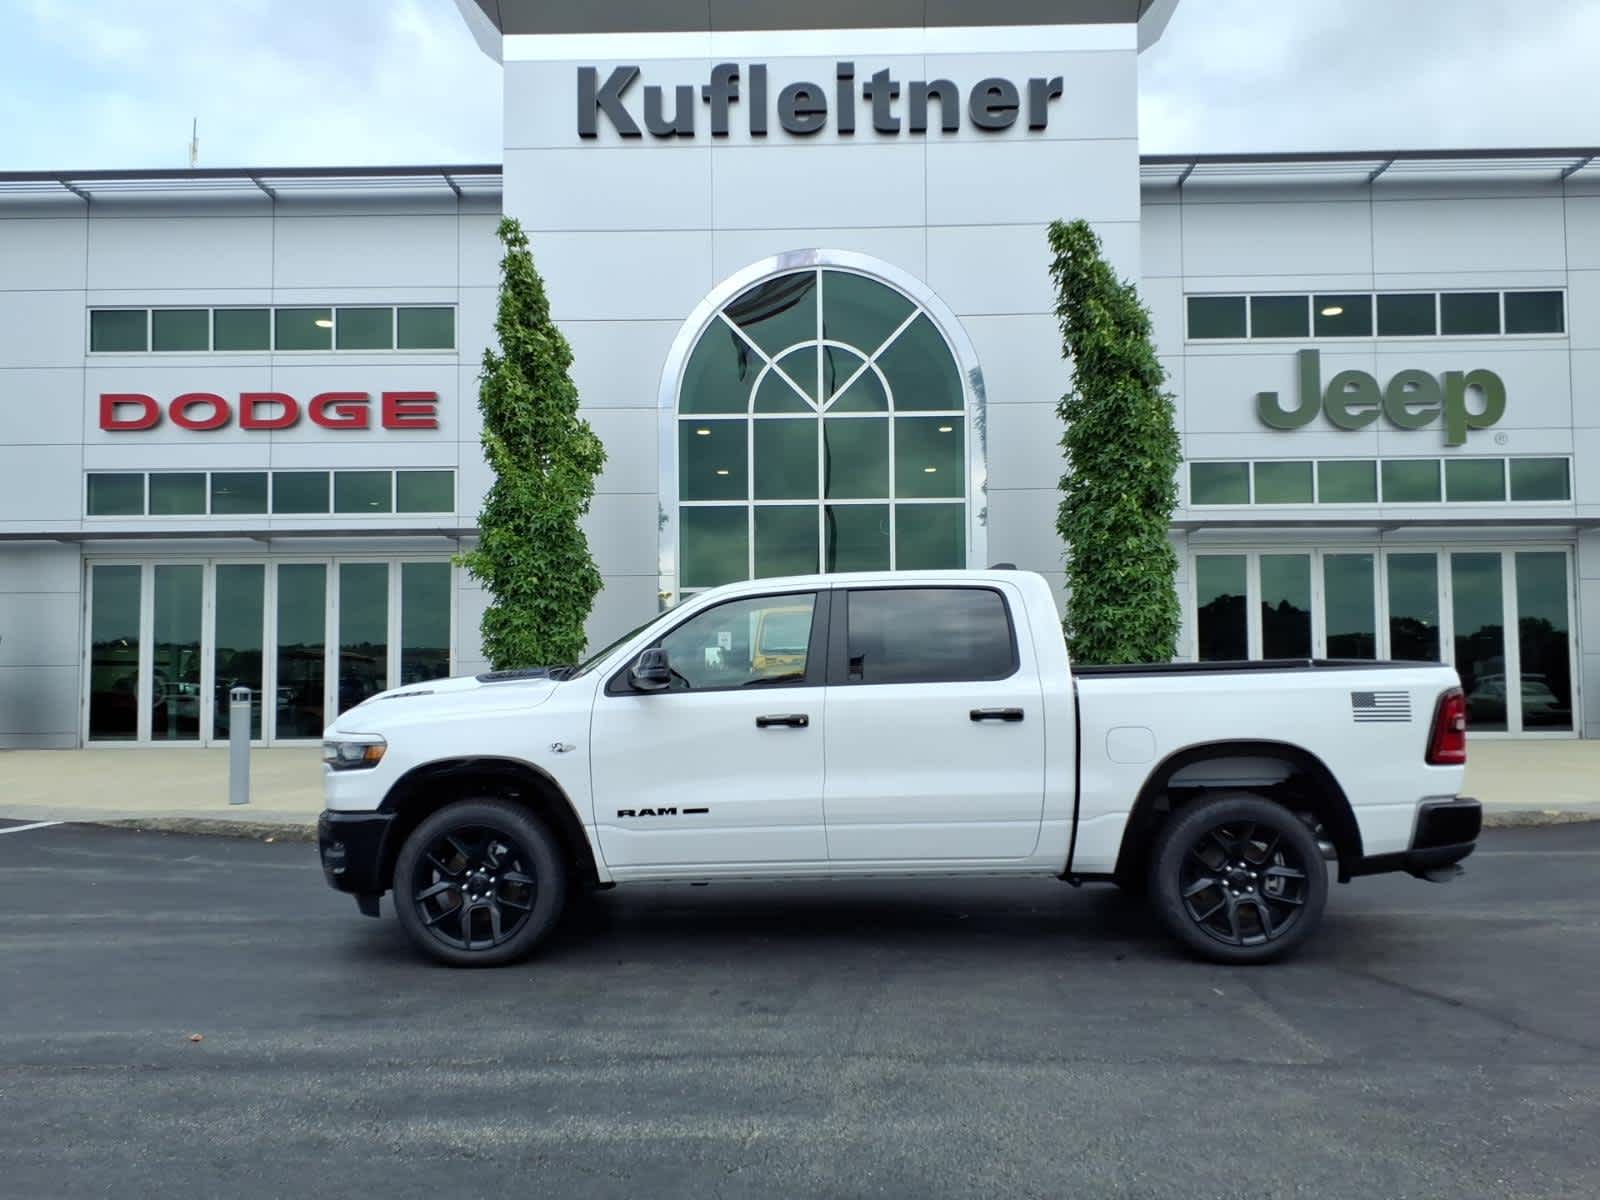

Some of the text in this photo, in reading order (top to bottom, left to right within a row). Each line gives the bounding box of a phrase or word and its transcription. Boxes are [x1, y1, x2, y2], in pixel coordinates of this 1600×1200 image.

[577, 62, 1064, 138] Kufleitner
[99, 391, 438, 431] DODGE
[1256, 349, 1507, 448] Jeep
[617, 807, 677, 818] RAM
